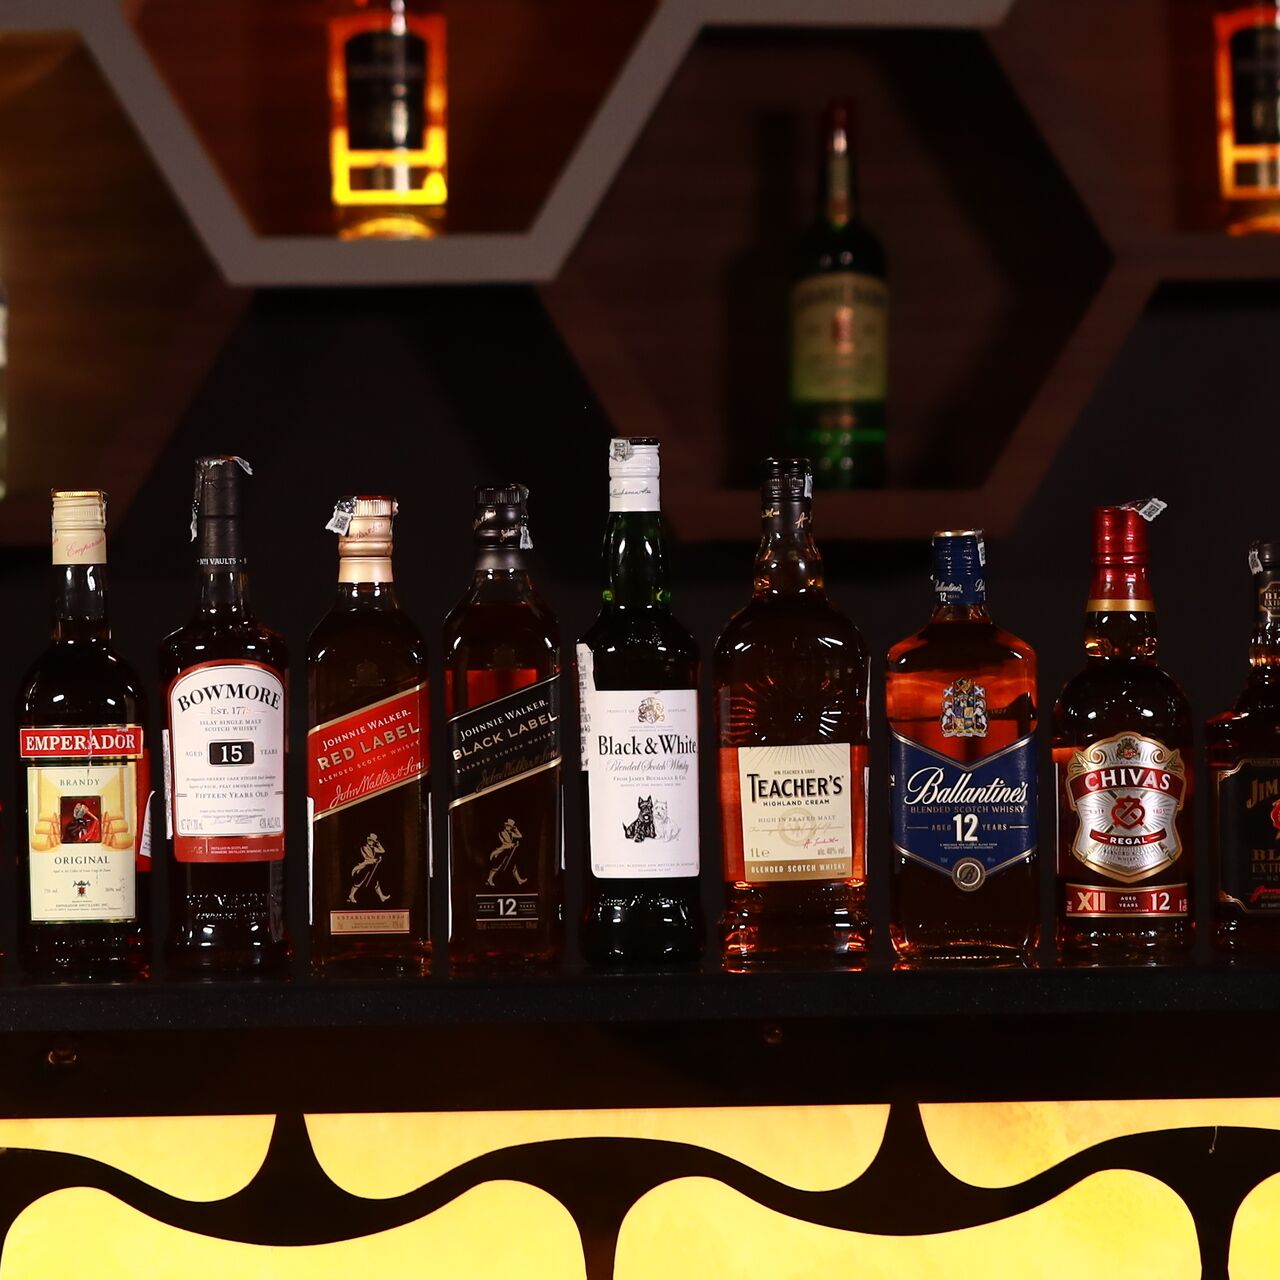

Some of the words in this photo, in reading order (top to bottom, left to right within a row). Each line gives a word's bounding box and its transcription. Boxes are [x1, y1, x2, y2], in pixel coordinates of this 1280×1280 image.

[209, 557, 237, 565] VAULTS
[177, 683, 282, 713] BOWMORE
[322, 725, 367, 751] JOHNNIE
[460, 716, 504, 741] JOHNNIE
[25, 734, 136, 751] EMPERADOR
[220, 744, 243, 763] 15
[260, 748, 278, 756] YEARS
[452, 732, 504, 761] BLACK
[456, 757, 491, 774] BLENDED
[494, 743, 524, 759] SCOTCH
[528, 730, 556, 745] WHISKY
[598, 734, 642, 757] Black
[644, 736, 658, 756] &
[658, 733, 697, 756] White
[317, 746, 356, 770] RED
[318, 767, 354, 784] BLENDED
[357, 753, 387, 769] SCOTCH
[390, 740, 420, 755] WHISKY
[606, 758, 641, 772] Blended
[641, 758, 666, 772] Scotch
[666, 755, 690, 775] Whisky
[59, 778, 100, 787] BRANDY
[747, 773, 843, 803] TEACHER'S
[904, 766, 1029, 805] Ballantine's
[1085, 768, 1171, 792] CHIVAS
[1246, 777, 1279, 809] JIM
[991, 805, 1025, 813] WHISKY
[952, 813, 978, 842] 12
[982, 823, 1007, 831] YEARS
[1109, 836, 1148, 845] REGAL
[54, 856, 110, 865] ORIGINAL
[751, 865, 784, 873] BLENDED
[788, 864, 816, 872] SCOTCH
[820, 863, 846, 871] WHISKY
[497, 898, 517, 916] 12
[1077, 892, 1106, 911] XII
[1150, 892, 1171, 911] 12
